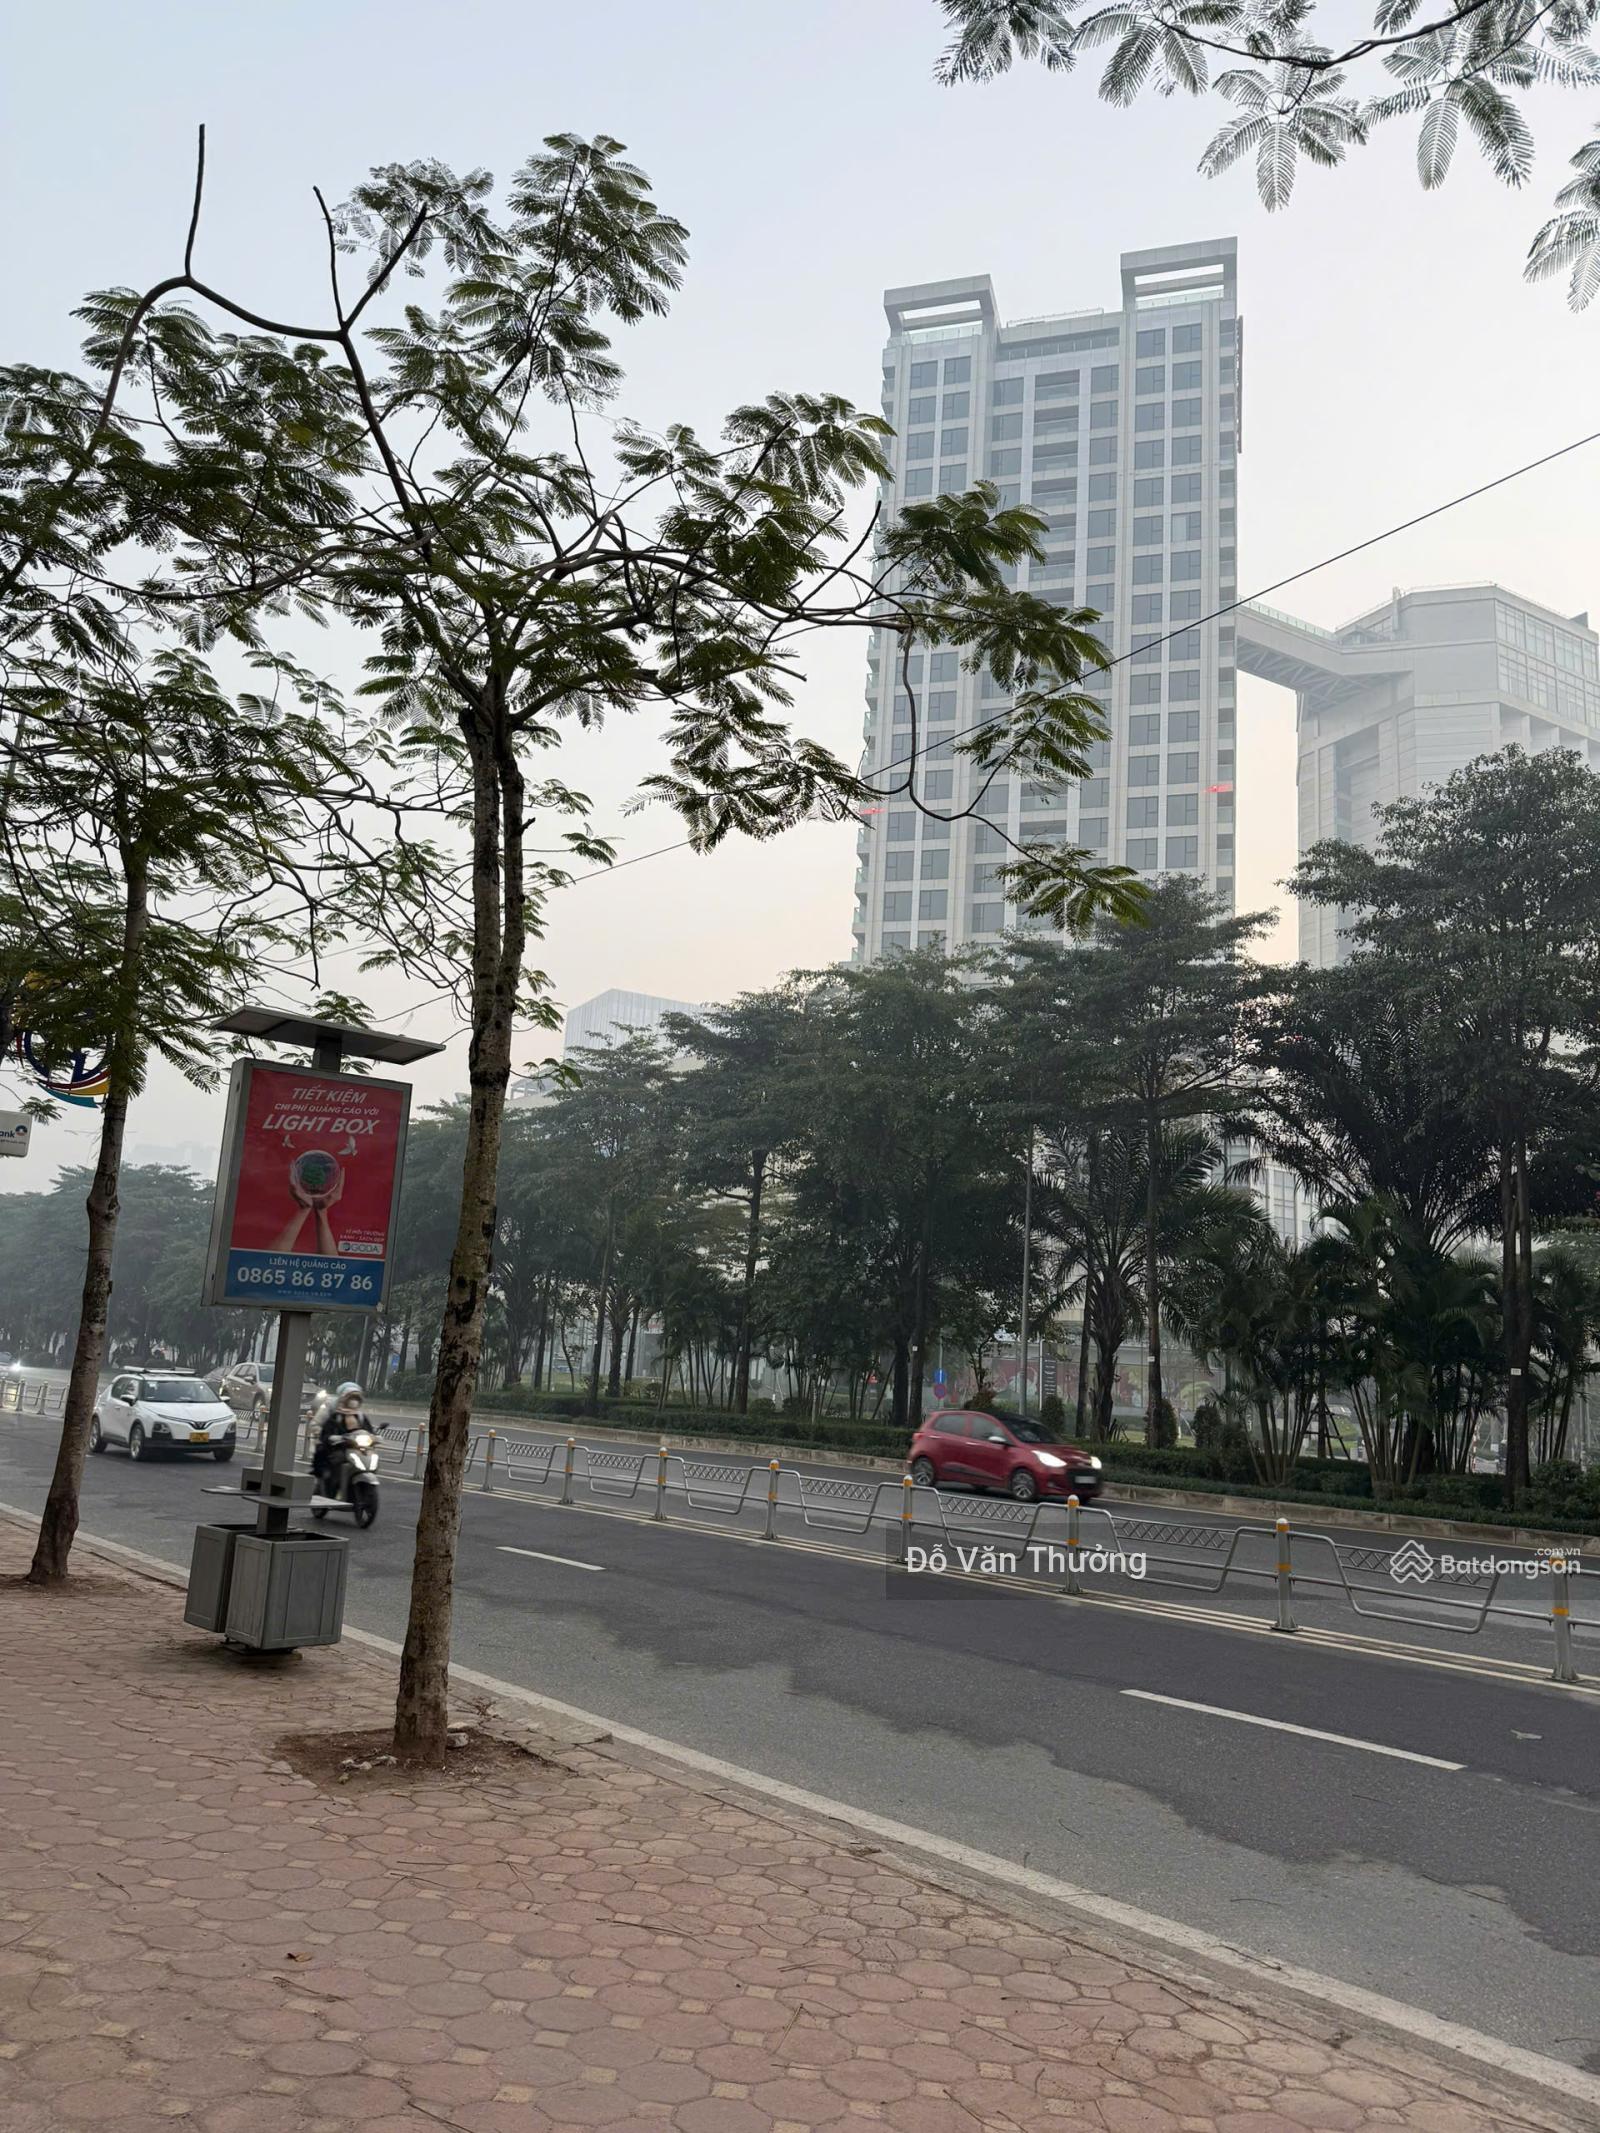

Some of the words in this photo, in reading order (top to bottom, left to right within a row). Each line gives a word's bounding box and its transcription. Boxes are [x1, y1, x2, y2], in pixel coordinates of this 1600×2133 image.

[292, 1085, 325, 1100] TIẾT
[325, 1088, 367, 1105] KIỆM
[262, 1114, 330, 1132] LIGHT
[330, 1117, 380, 1134] BOX
[269, 1257, 288, 1266] LIÊN
[289, 1258, 301, 1269] HỆ
[301, 1258, 329, 1269] QUẢNG
[237, 1267, 286, 1285] 0865
[291, 1270, 315, 1287] 86
[320, 1272, 345, 1289] 87
[350, 1274, 373, 1290] 86
